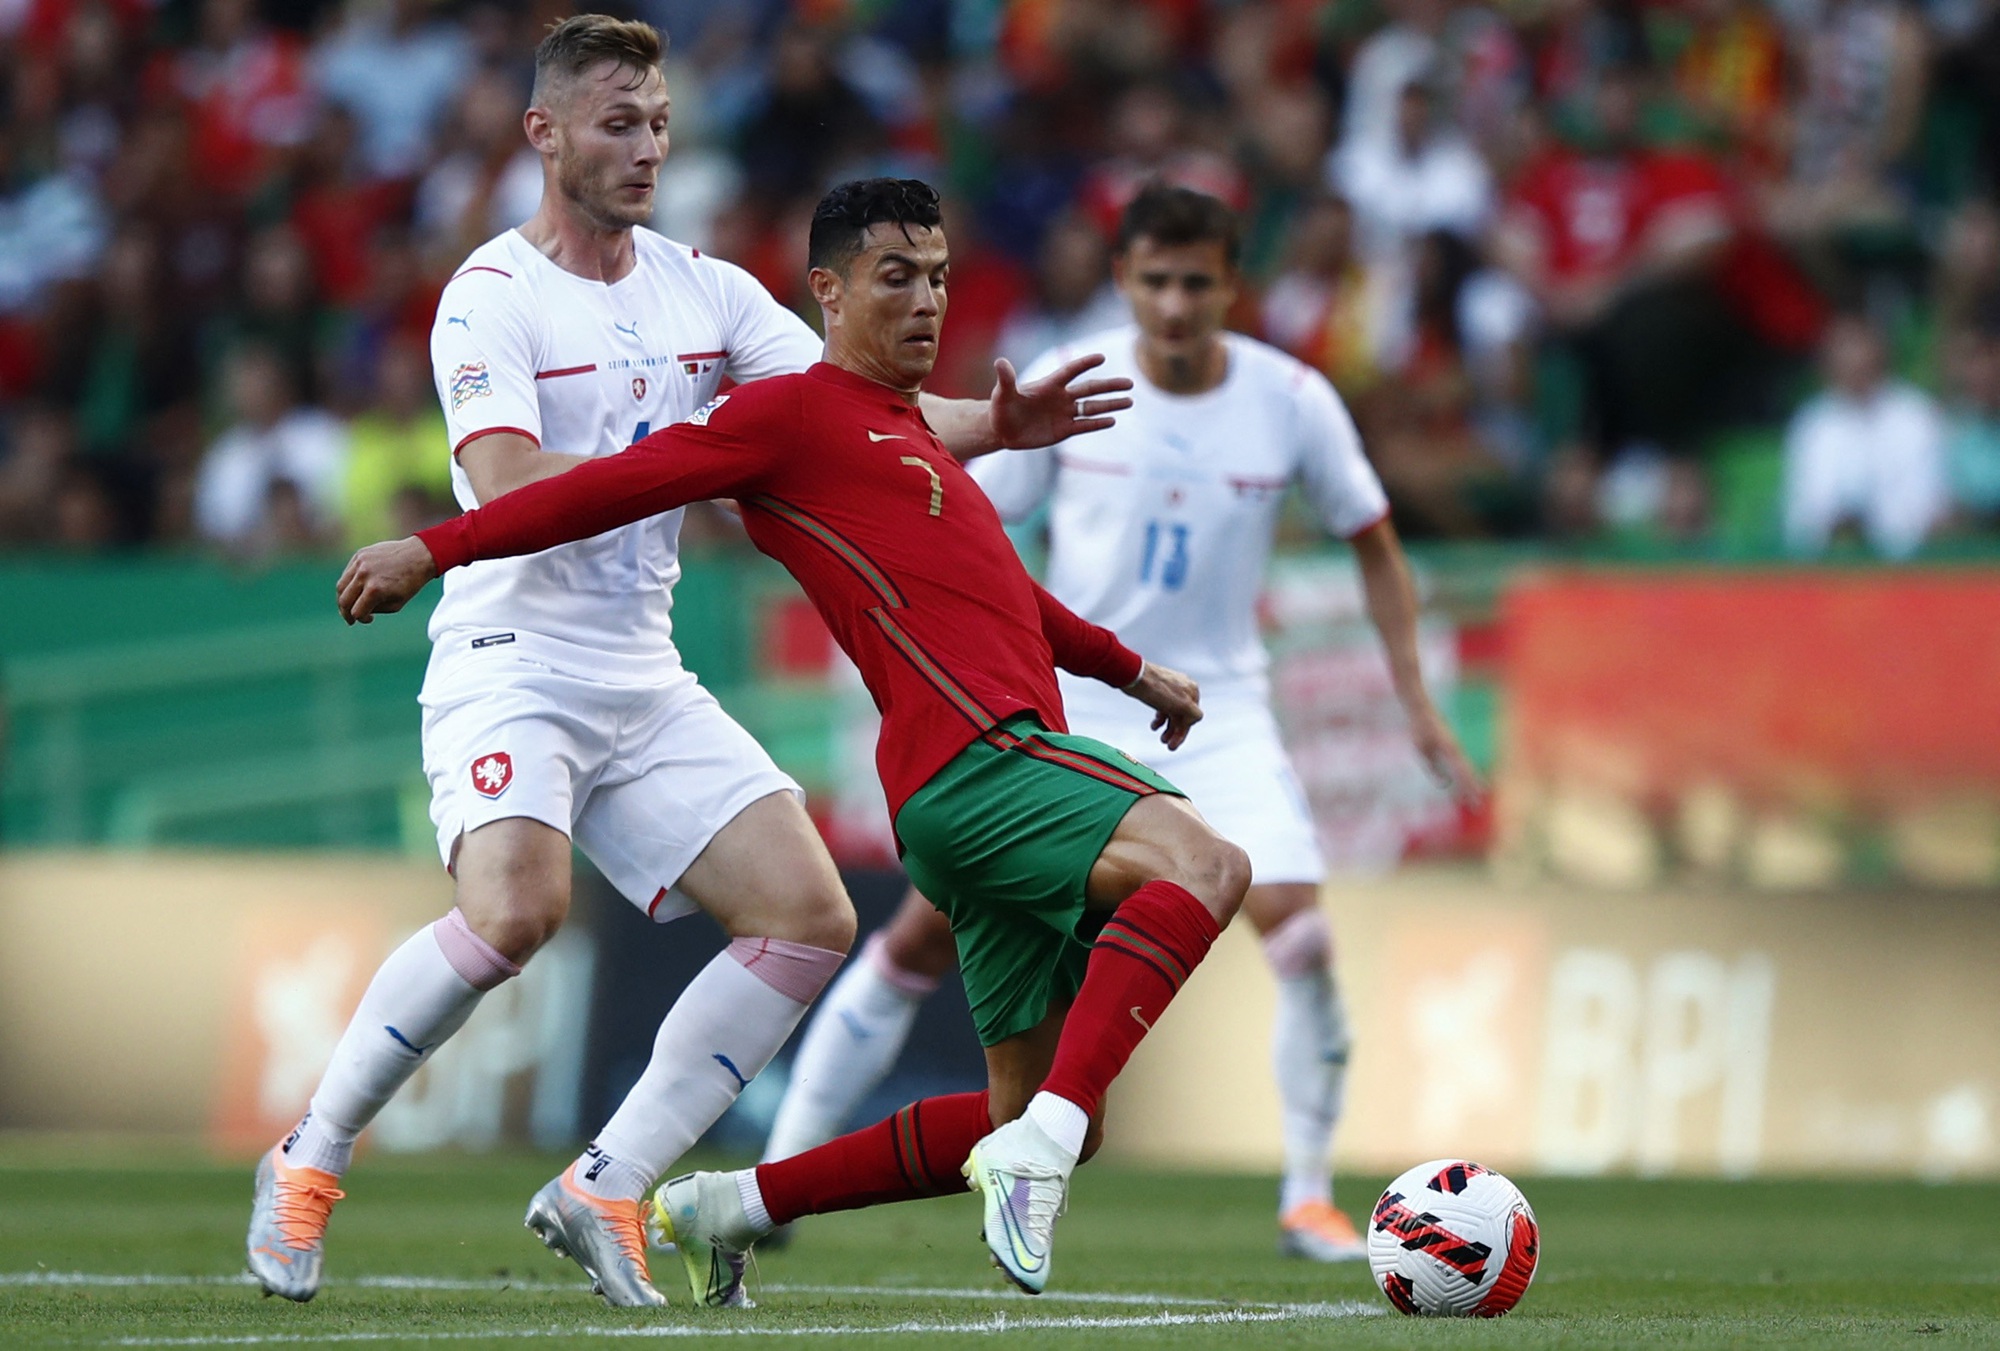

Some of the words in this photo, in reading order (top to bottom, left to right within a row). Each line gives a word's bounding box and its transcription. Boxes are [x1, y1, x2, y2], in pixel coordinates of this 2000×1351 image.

[899, 456, 943, 517] 7
[1140, 520, 1189, 590] 13
[1530, 946, 1775, 1180] BPI
